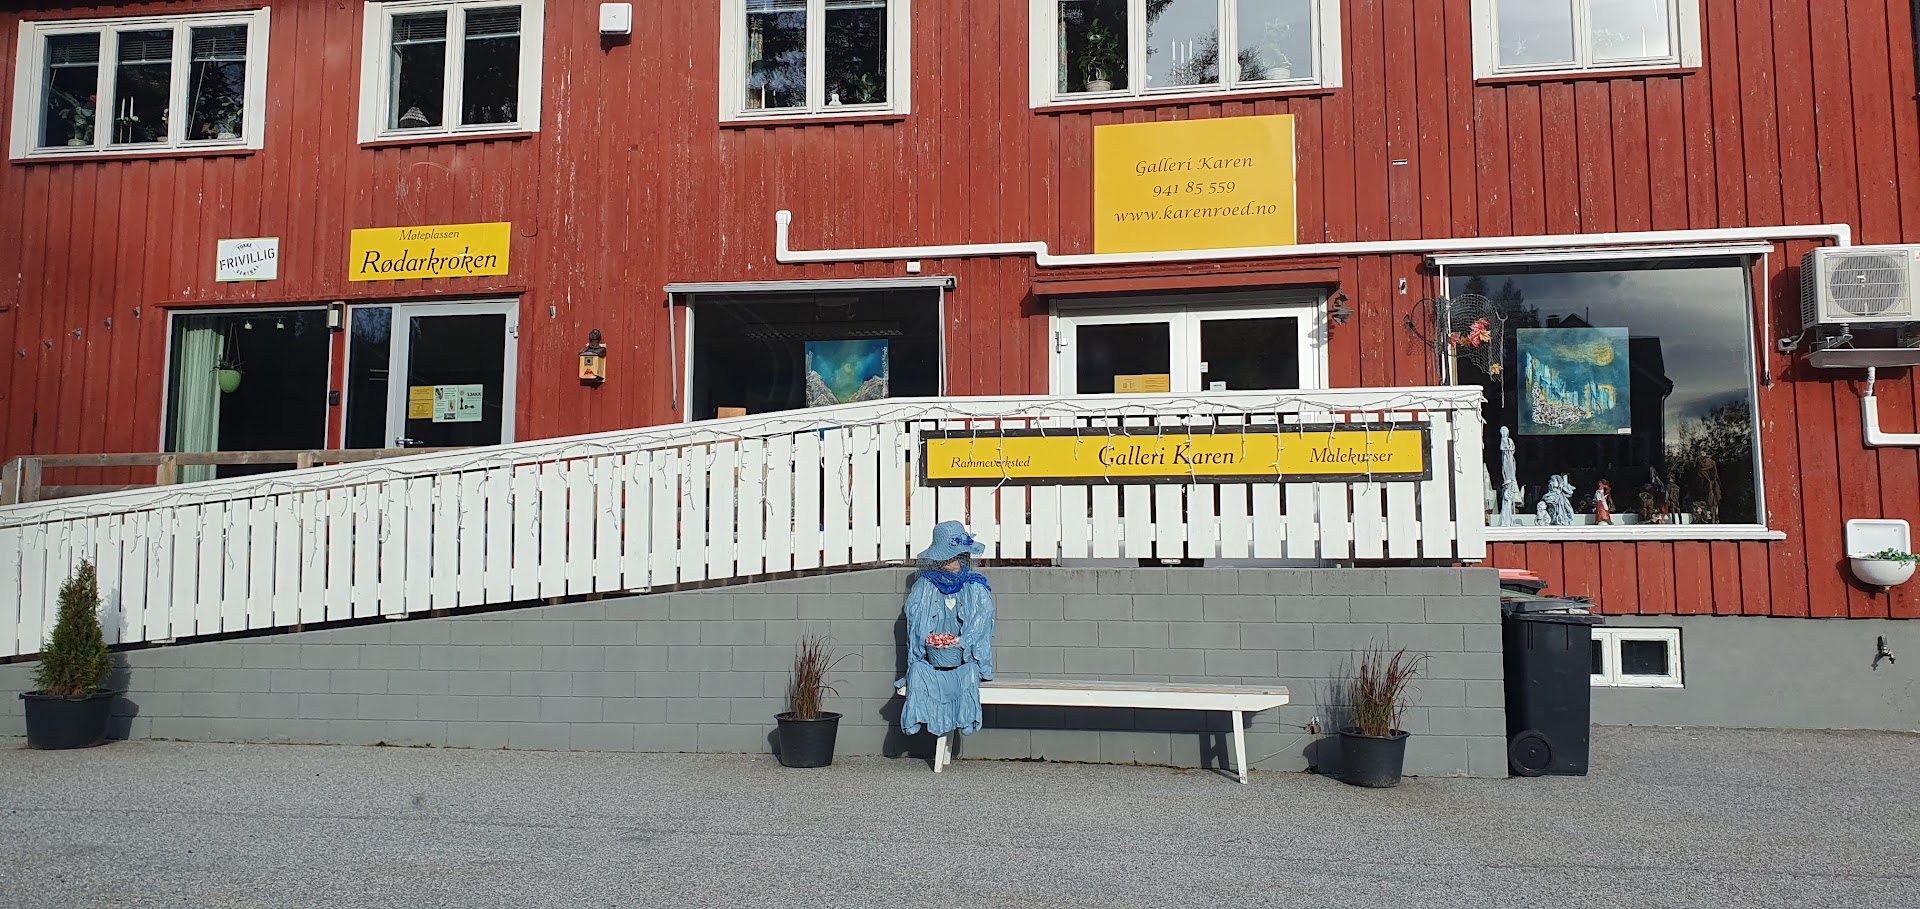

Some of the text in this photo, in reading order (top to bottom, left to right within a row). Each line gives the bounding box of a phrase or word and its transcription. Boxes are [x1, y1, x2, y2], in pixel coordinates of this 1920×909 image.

[1135, 156, 1254, 177] Galleri Karen
[1153, 181, 1236, 198] 941 85 559
[1114, 201, 1277, 222] www.karenroed.no
[399, 228, 460, 242] Møteplassen
[219, 248, 275, 271] FRIVILLIG
[360, 246, 497, 275] Rødarkroken
[951, 455, 1031, 468] Rammeverksted
[1098, 444, 1234, 466] Galleri Karen
